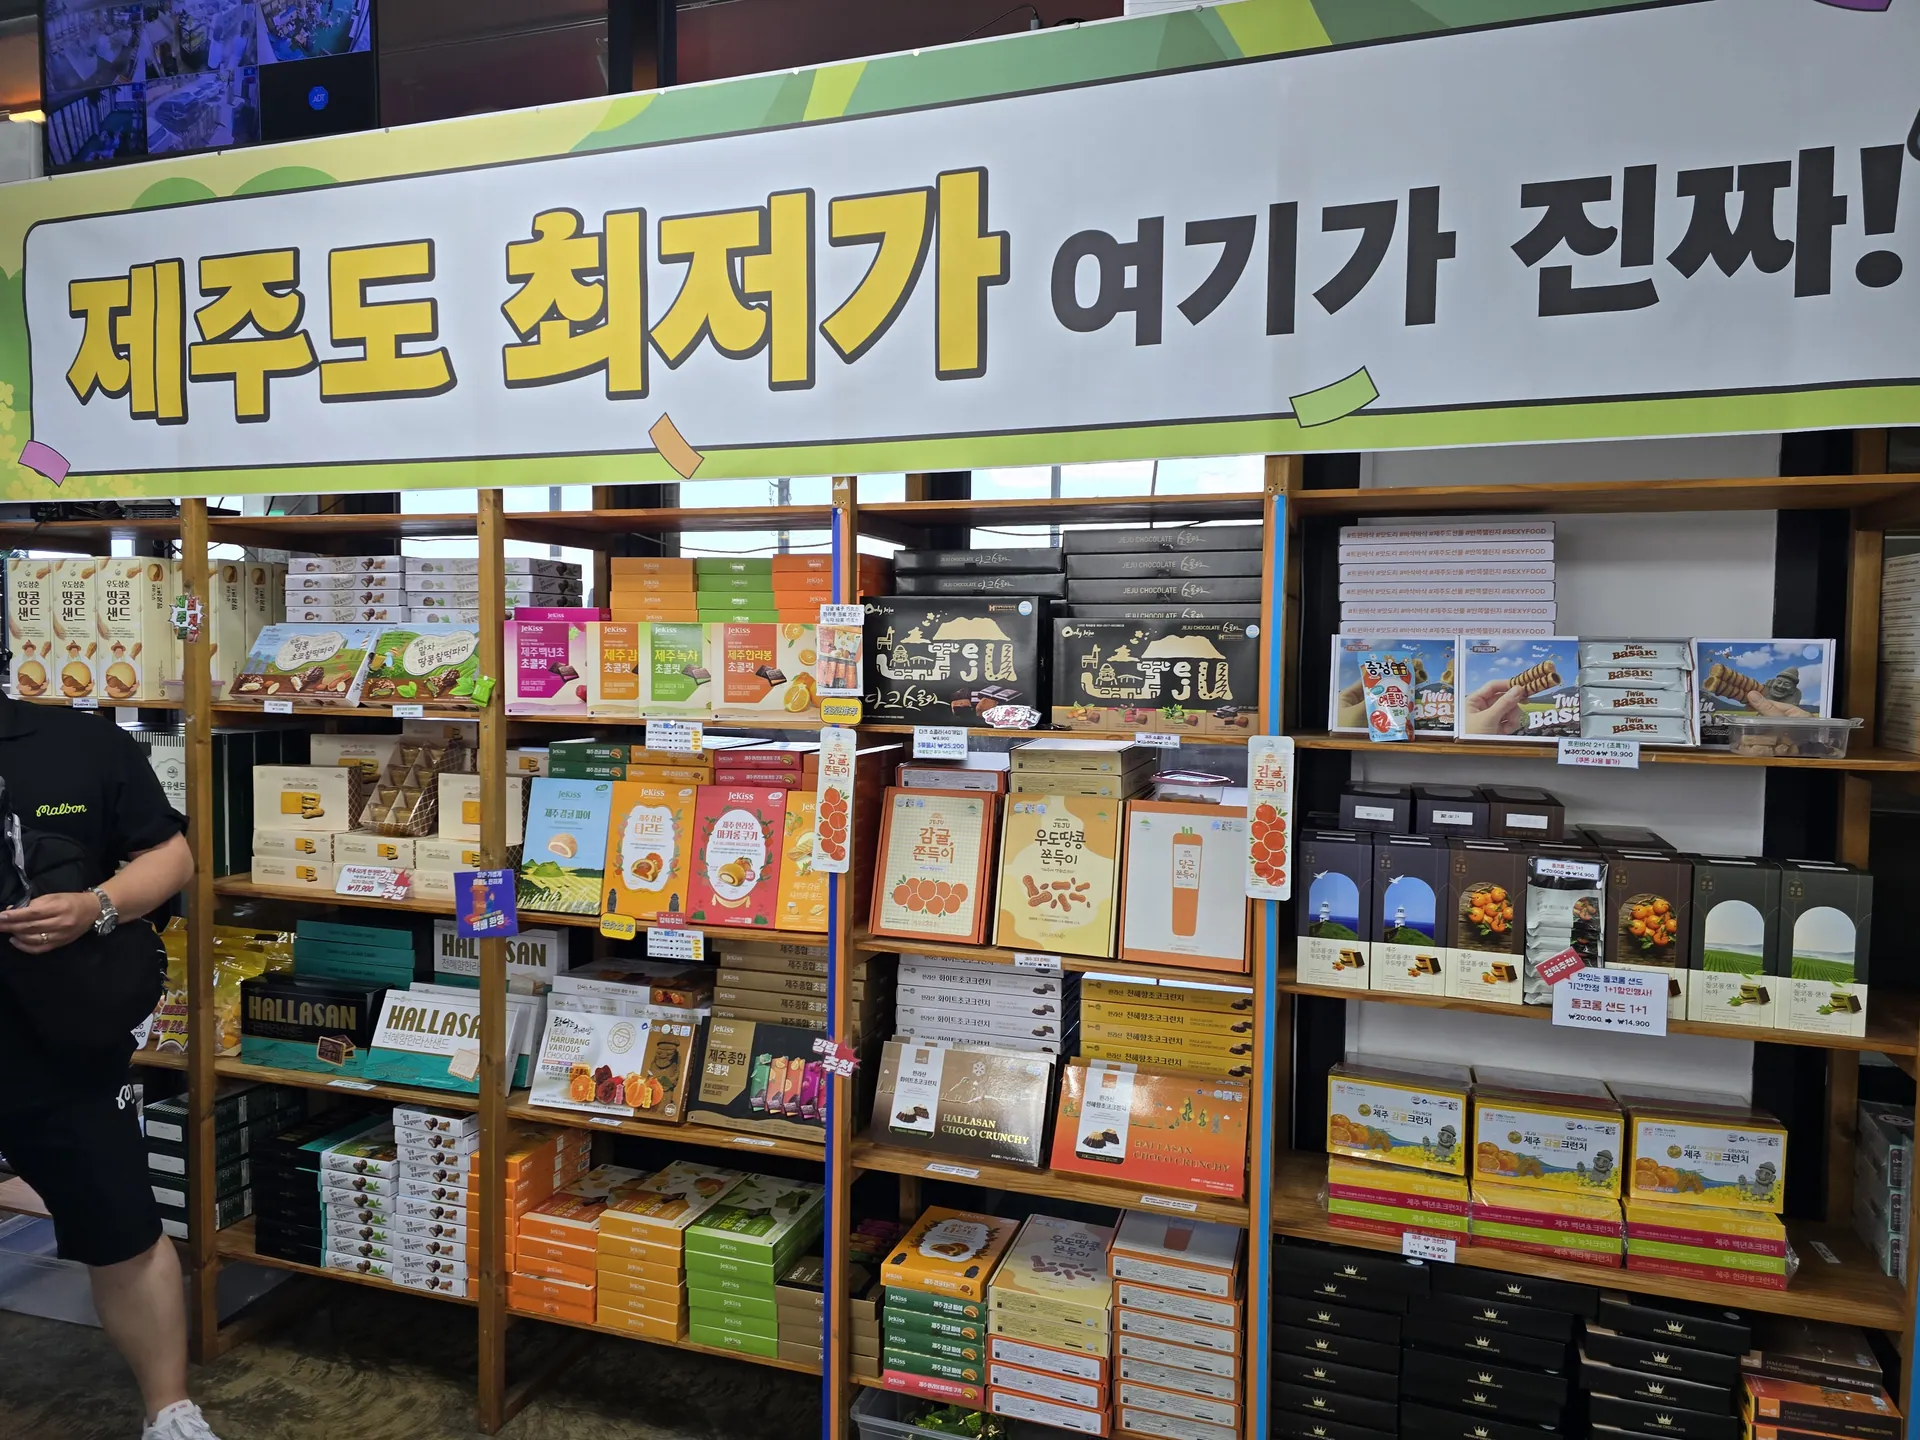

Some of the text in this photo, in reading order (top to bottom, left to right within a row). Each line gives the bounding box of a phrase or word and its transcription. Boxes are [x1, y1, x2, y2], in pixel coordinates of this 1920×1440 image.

[66, 143, 1905, 427] 제주도 최저가 여기가 진짜!
[17, 591, 41, 606] 땅콩
[62, 591, 86, 606] 땅콩
[106, 590, 131, 605] 땅콩
[17, 607, 41, 622] 샌드
[62, 607, 86, 622] 샌드
[106, 606, 131, 621] 샌드
[521, 625, 544, 633] JeKiss
[654, 626, 677, 634] JeKiss
[728, 627, 751, 635] JeKiss
[521, 659, 548, 670] 초콜릿
[604, 663, 631, 674] 초콜릿
[654, 662, 681, 674] 초콜릿
[728, 662, 754, 673] 초콜릿
[1365, 660, 1389, 675] 증정
[824, 766, 849, 777] 쫀득이
[1254, 779, 1286, 792] 쫀득이
[558, 790, 582, 799] JeKiss
[641, 788, 665, 797] JeKiss
[728, 792, 754, 801] JeKiss
[36, 803, 87, 817] Malbon
[545, 808, 591, 820] 제주 감귤 파이
[651, 815, 662, 823] 감귤
[634, 823, 665, 835] 타르트
[722, 821, 755, 831] 제주 한라봉
[717, 830, 742, 840] 마카롱
[1035, 830, 1086, 849] 우도땅콩
[913, 845, 954, 864] 쫀득이
[1040, 849, 1078, 866] 쫀득이
[1179, 860, 1195, 870] 당근
[1176, 870, 1197, 879] 쫀득이
[489, 914, 504, 928] 환영
[1544, 958, 1577, 978] 강력추천!
[939, 974, 991, 986] 화이트초코크런치
[1578, 973, 1600, 983] 맛있는
[1603, 975, 1625, 984] 돌코롬
[1568, 982, 1599, 992] 기간한정
[938, 995, 991, 1007] 화이트초코크런치
[1127, 989, 1184, 1001] 천혜향초코크런치
[1571, 998, 1647, 1015] 돌코롬 샌드 1+1
[249, 995, 357, 1031] HALLASAN
[1127, 1011, 1183, 1024] 천혜향초코크런치
[1617, 1019, 1650, 1027] ₩14,900
[713, 1025, 734, 1034] JeKiss
[382, 1031, 450, 1050] 천혜향한라산샌드
[550, 1036, 590, 1046] HARUBANG
[549, 1044, 580, 1053] VARIOUS
[547, 1051, 584, 1061] CHOCOLATE
[709, 1049, 746, 1065] 제주종합
[706, 1063, 729, 1076] 초콜릿
[900, 1077, 937, 1087] 화이트초코크런치
[1373, 1109, 1389, 1119] 제주
[943, 1113, 996, 1128] HALLASAN
[942, 1125, 1029, 1145] CHOCO CRUNCHY
[1524, 1135, 1541, 1145] 제주
[1134, 1139, 1192, 1154] HALLASAN
[1684, 1150, 1701, 1159] 제주
[1133, 1151, 1230, 1172] CHOCO CRUNCHY
[890, 1294, 907, 1302] JeKiss
[888, 1356, 906, 1365] JeKiss
